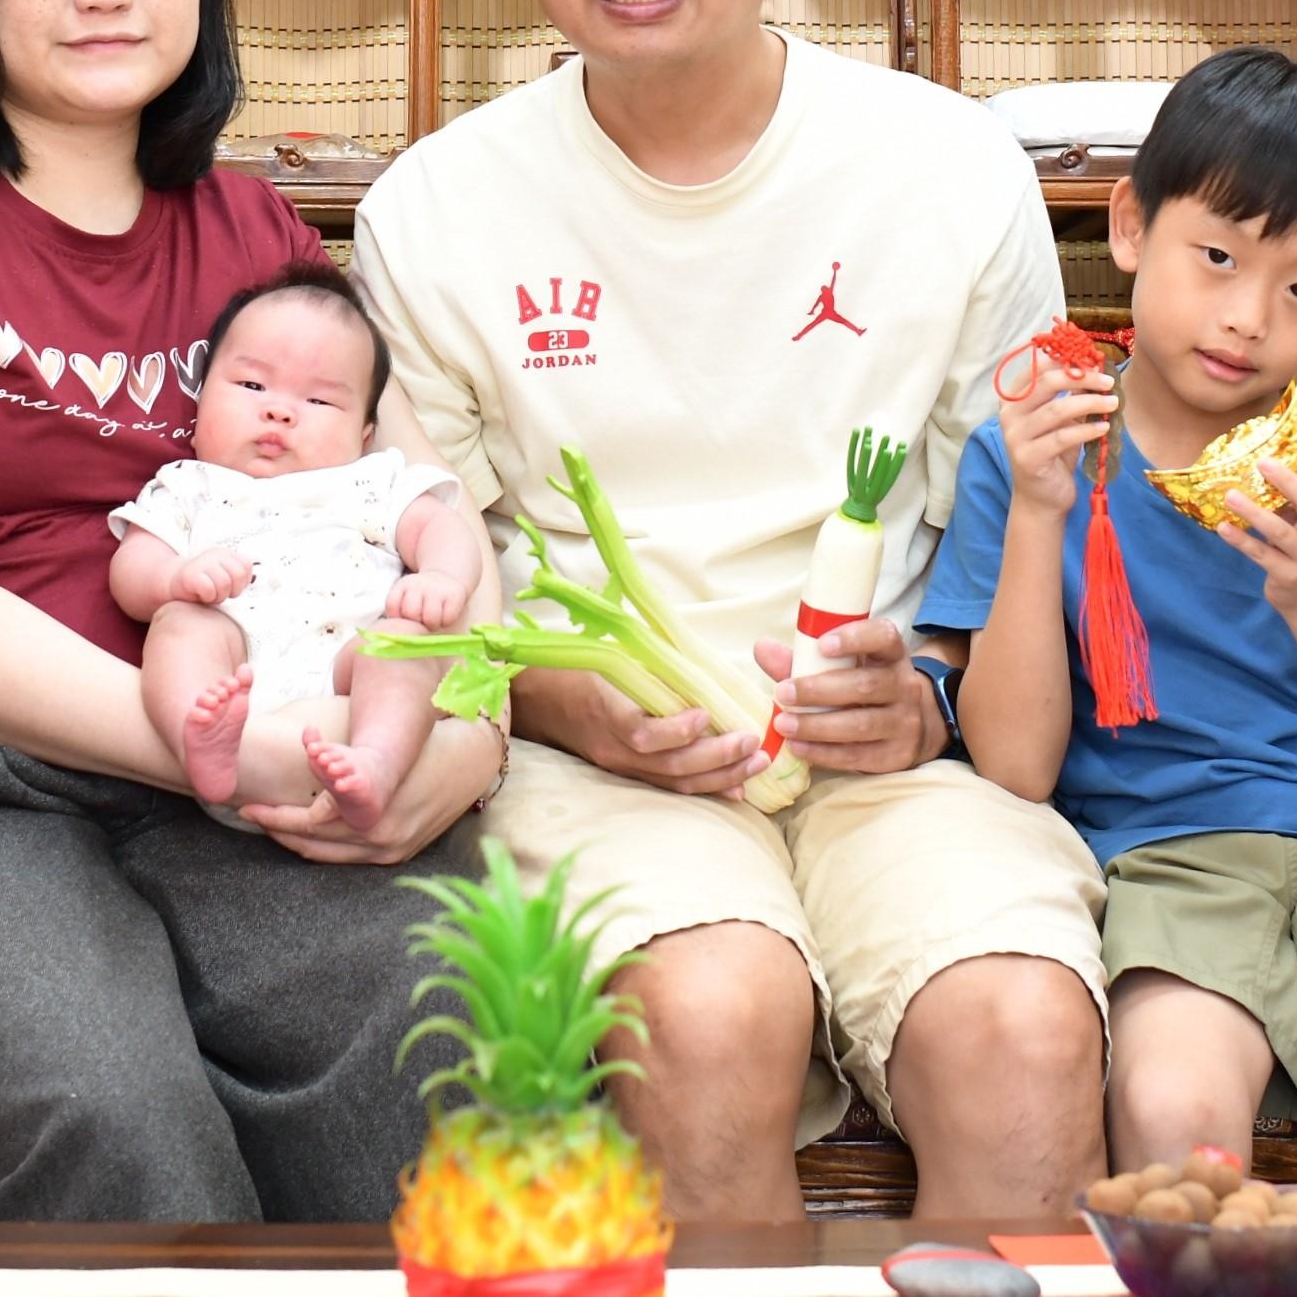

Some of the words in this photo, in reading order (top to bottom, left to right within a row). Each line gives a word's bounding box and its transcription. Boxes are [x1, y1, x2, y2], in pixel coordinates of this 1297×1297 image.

[515, 277, 602, 325] AIR
[547, 330, 569, 350] 23
[521, 354, 597, 369] JORDAN
[64, 404, 125, 437] day
